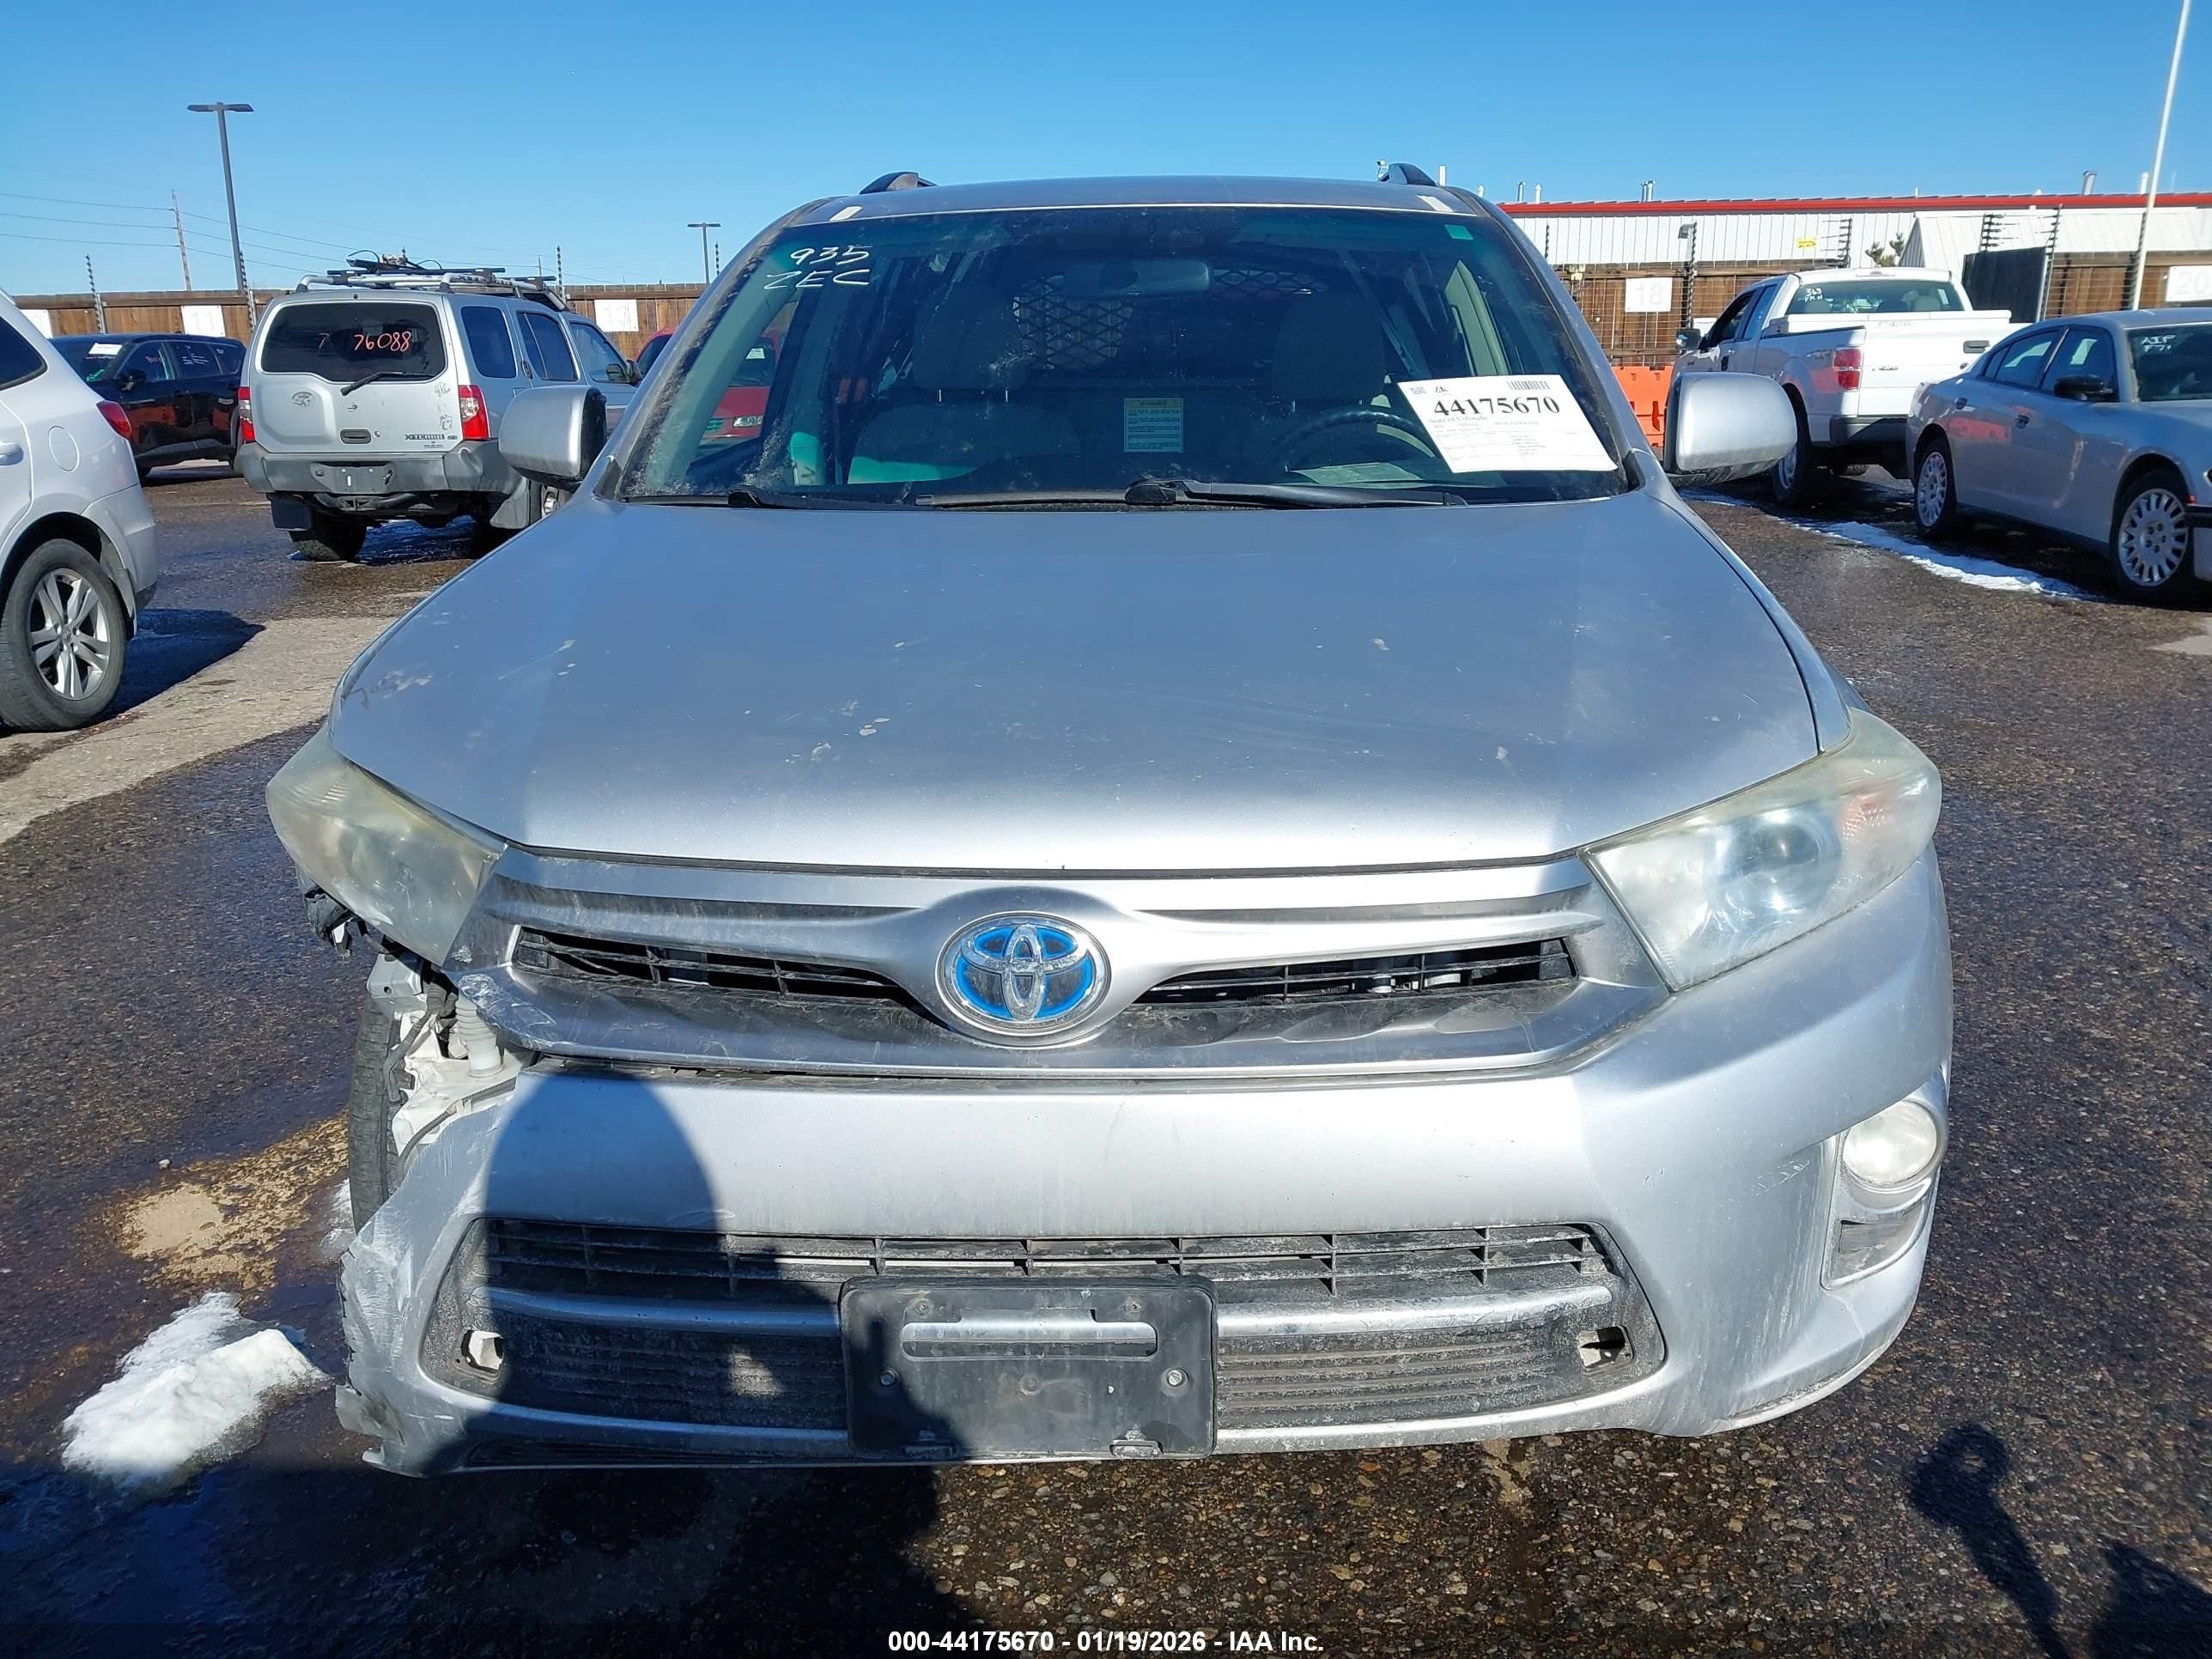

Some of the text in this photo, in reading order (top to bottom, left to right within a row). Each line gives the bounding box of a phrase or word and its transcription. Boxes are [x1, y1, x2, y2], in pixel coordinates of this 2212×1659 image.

[790, 244, 872, 265] 935
[763, 269, 870, 289] ZEC
[1634, 282, 1664, 307] 18
[354, 331, 411, 352] 76088
[1434, 397, 1560, 416] 44175670
